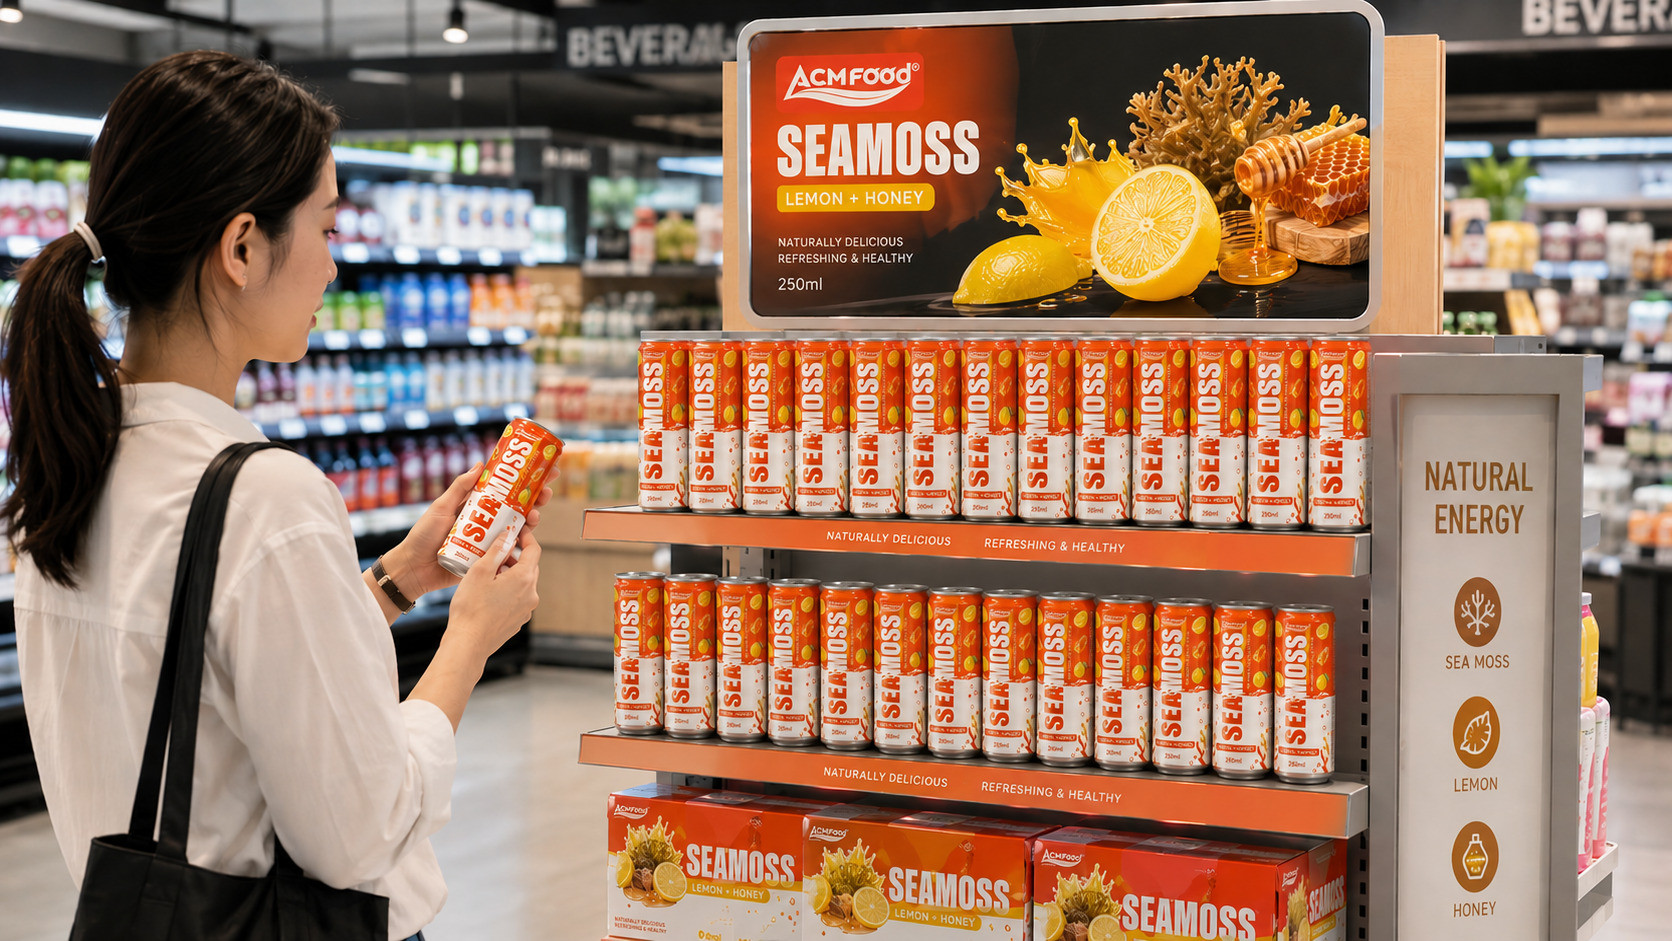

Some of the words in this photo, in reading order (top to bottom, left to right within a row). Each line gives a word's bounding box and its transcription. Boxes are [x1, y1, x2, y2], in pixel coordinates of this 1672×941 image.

[777, 120, 980, 177] SEAMOSS
[786, 192, 843, 205] LEMON
[850, 194, 858, 203] +
[865, 191, 923, 204] HONEY
[778, 237, 841, 247] NATURALLY
[845, 237, 903, 247] DELICIOUS
[778, 253, 847, 264] REFRESHING
[851, 253, 859, 263] &
[862, 253, 913, 263] HEALTHY
[778, 277, 823, 291] 250ml
[643, 362, 663, 480] SEAMOSS
[694, 362, 715, 481] SEAMOSS
[749, 362, 769, 483] SEAMOSS
[802, 363, 824, 483] SEAMOSS
[857, 362, 879, 485] SEAMOSS
[912, 363, 935, 486] SEAMOSS
[968, 363, 990, 488] SEAMOSS
[1026, 363, 1049, 489] SEAMOSS
[1083, 363, 1106, 490] SEAMOSS
[1141, 363, 1164, 491] SEAMOSS
[1198, 363, 1221, 491] SEAMOSS
[1257, 363, 1281, 493] SEAMOSS
[1320, 363, 1345, 494] SEAMOSS
[462, 437, 533, 543] SEAMOSS
[1425, 461, 1533, 491] NATURAL
[1435, 504, 1524, 534] ENERGY
[826, 531, 889, 543] NATURALLY
[892, 534, 951, 546] DELICIOUS
[984, 538, 1056, 551] REFRESHING
[1060, 541, 1067, 551] &
[1072, 541, 1126, 554] HEALTHY
[620, 600, 640, 701] SEAMOSS
[670, 602, 690, 704] SEAMOSS
[722, 605, 742, 707] SEAMOSS
[774, 608, 793, 711] SEAMOSS
[827, 611, 847, 715] SEAMOSS
[880, 614, 901, 719] SEAMOSS
[934, 617, 955, 723] SEAMOSS
[989, 620, 1010, 727] SEAMOSS
[1044, 623, 1065, 731] SEAMOSS
[1102, 626, 1123, 734] SEAMOSS
[1161, 629, 1183, 738] SEAMOSS
[1221, 632, 1244, 742] SEAMOSS
[1284, 635, 1307, 745] SEAMOSS
[1445, 655, 1470, 669] SEA
[1474, 654, 1510, 669] MOSS
[823, 766, 886, 782] NATURALLY
[889, 773, 948, 788] DELICIOUS
[982, 781, 1053, 798] REFRESHING
[1057, 789, 1064, 799] &
[1068, 790, 1122, 804] HEALTHY
[1454, 777, 1498, 792] LEMON
[686, 844, 795, 888] SEAMOSS
[692, 883, 723, 895] LEMON
[733, 888, 765, 900] HONEY
[888, 866, 1010, 916] SEAMOSS
[894, 908, 929, 921] LEMON
[940, 914, 975, 927] HONEY
[1122, 894, 1256, 941] SEAMOSS
[1453, 901, 1496, 918] HONEY
